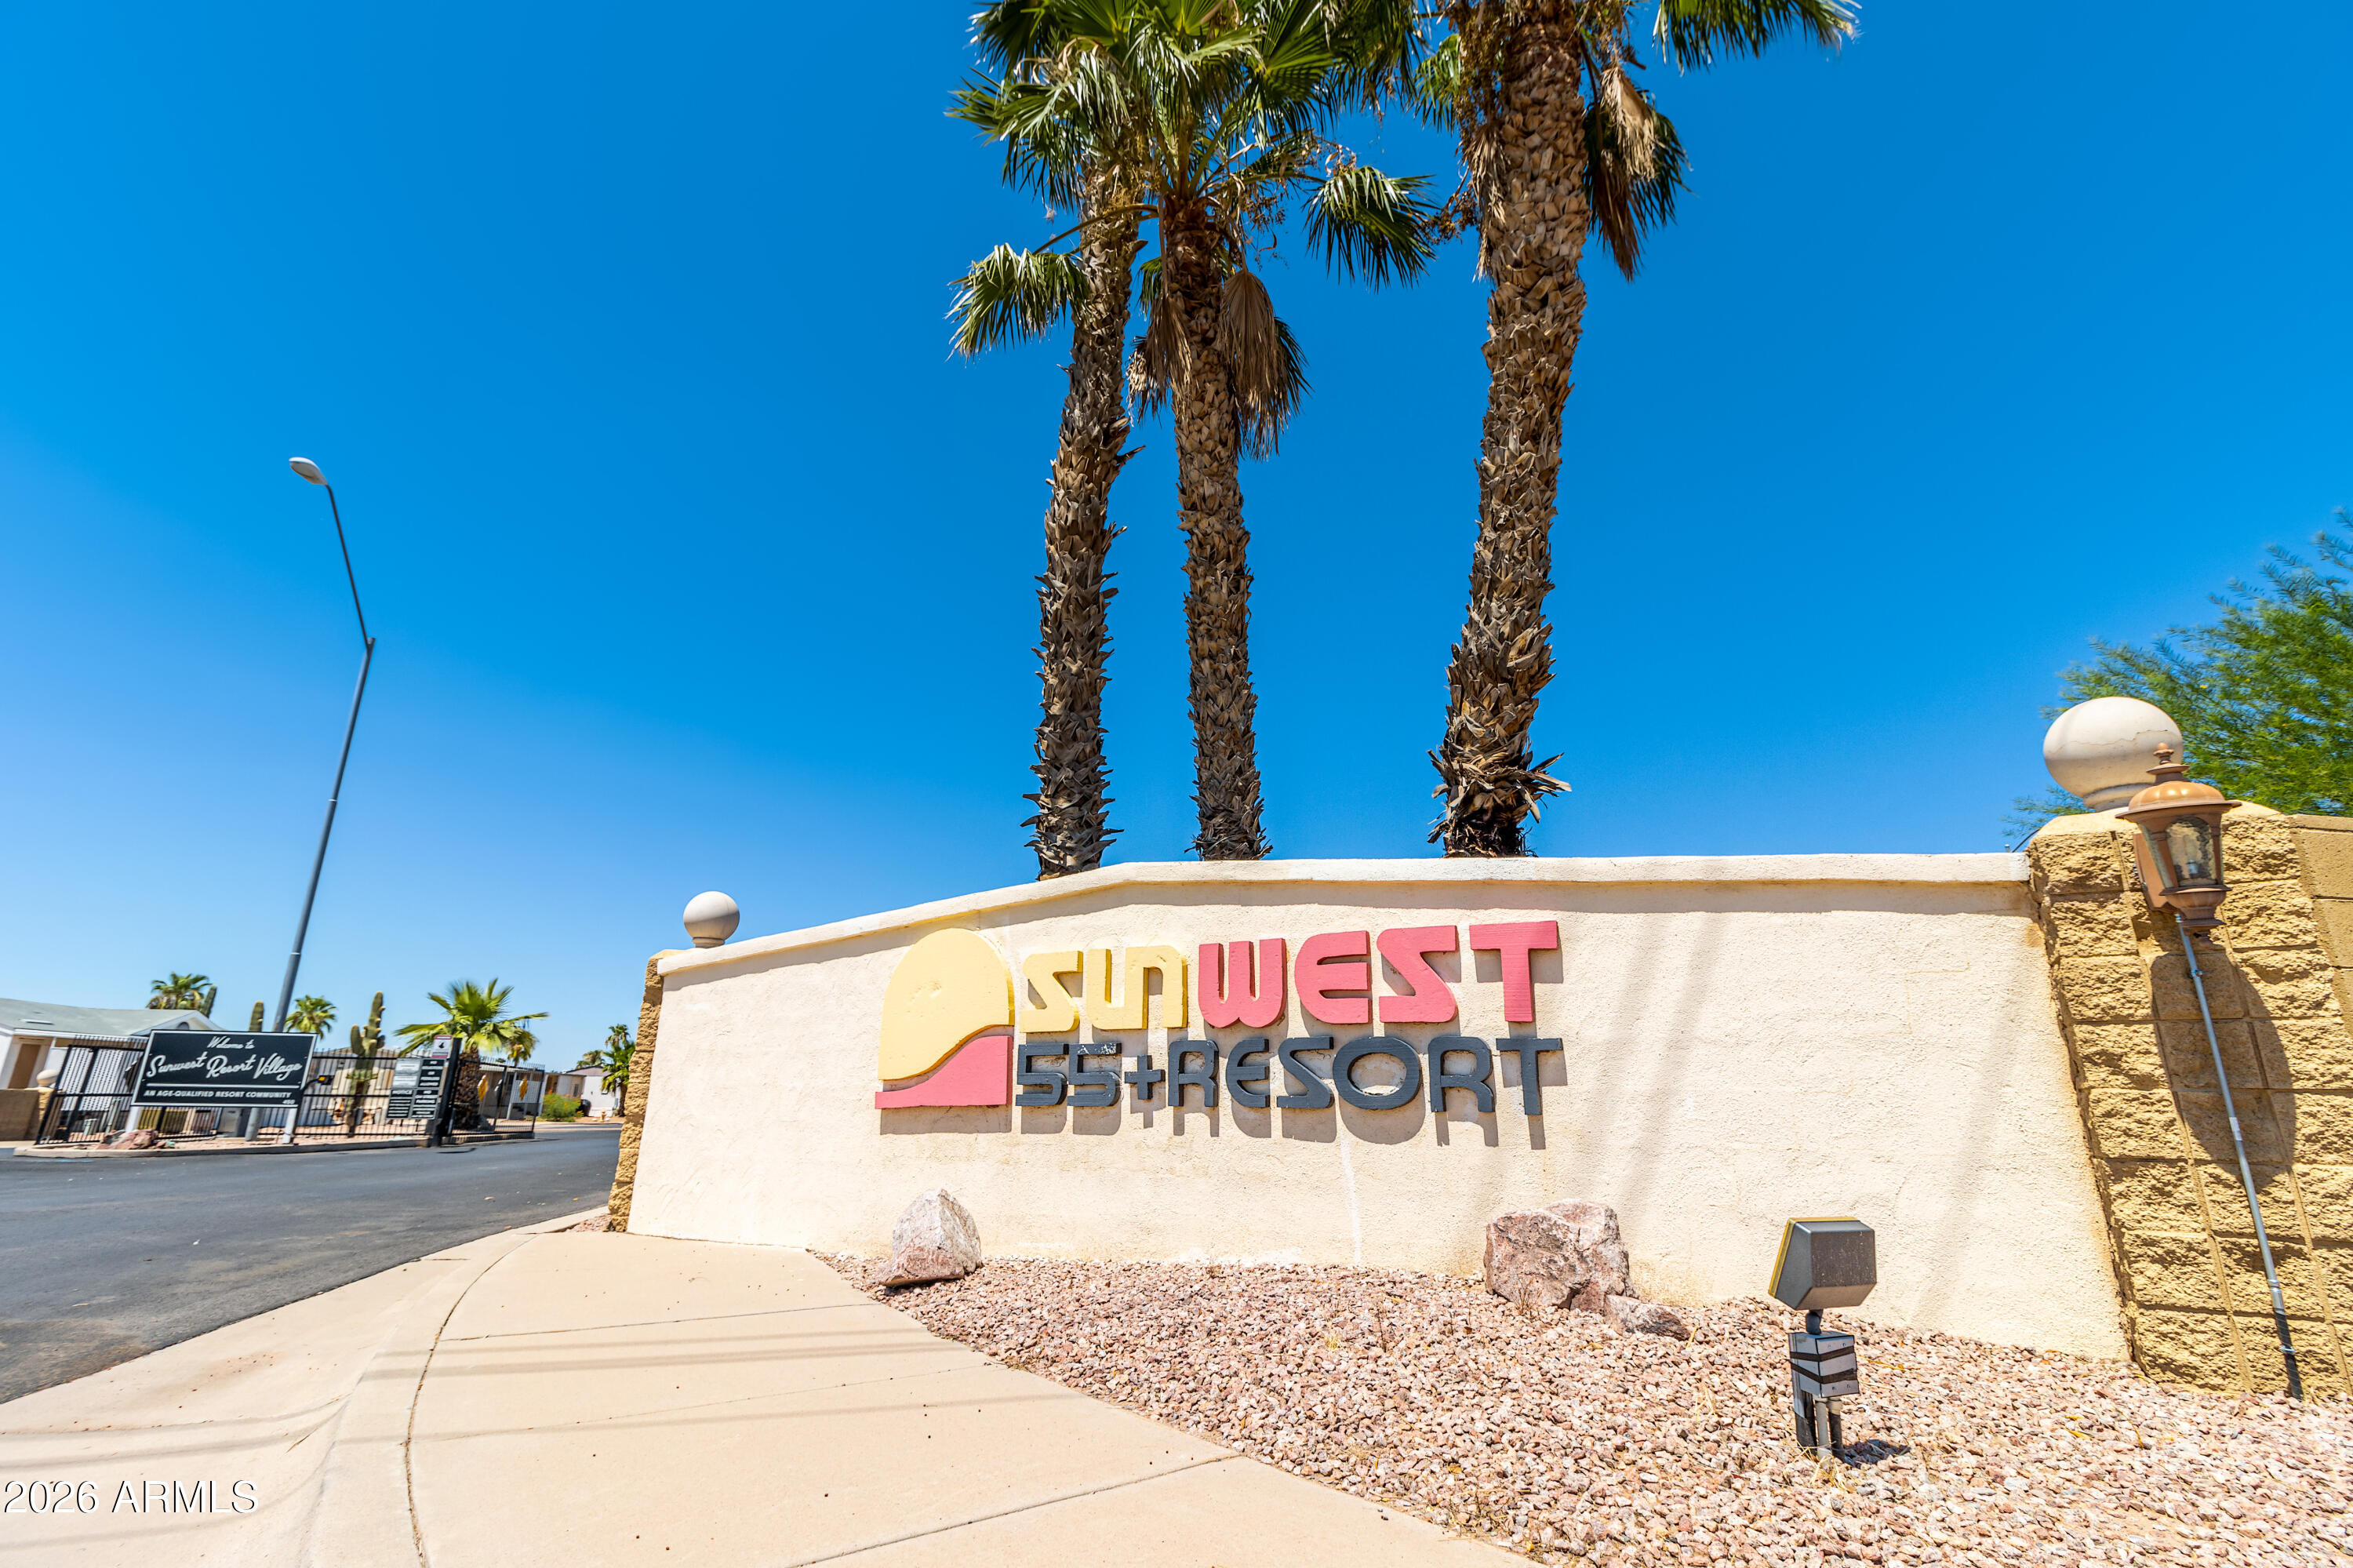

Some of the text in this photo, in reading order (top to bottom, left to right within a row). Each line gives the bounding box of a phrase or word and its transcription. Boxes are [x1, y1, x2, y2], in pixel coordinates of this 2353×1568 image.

[207, 1036, 255, 1049] Welcome to
[146, 1051, 303, 1081] Sunwest Resort Village
